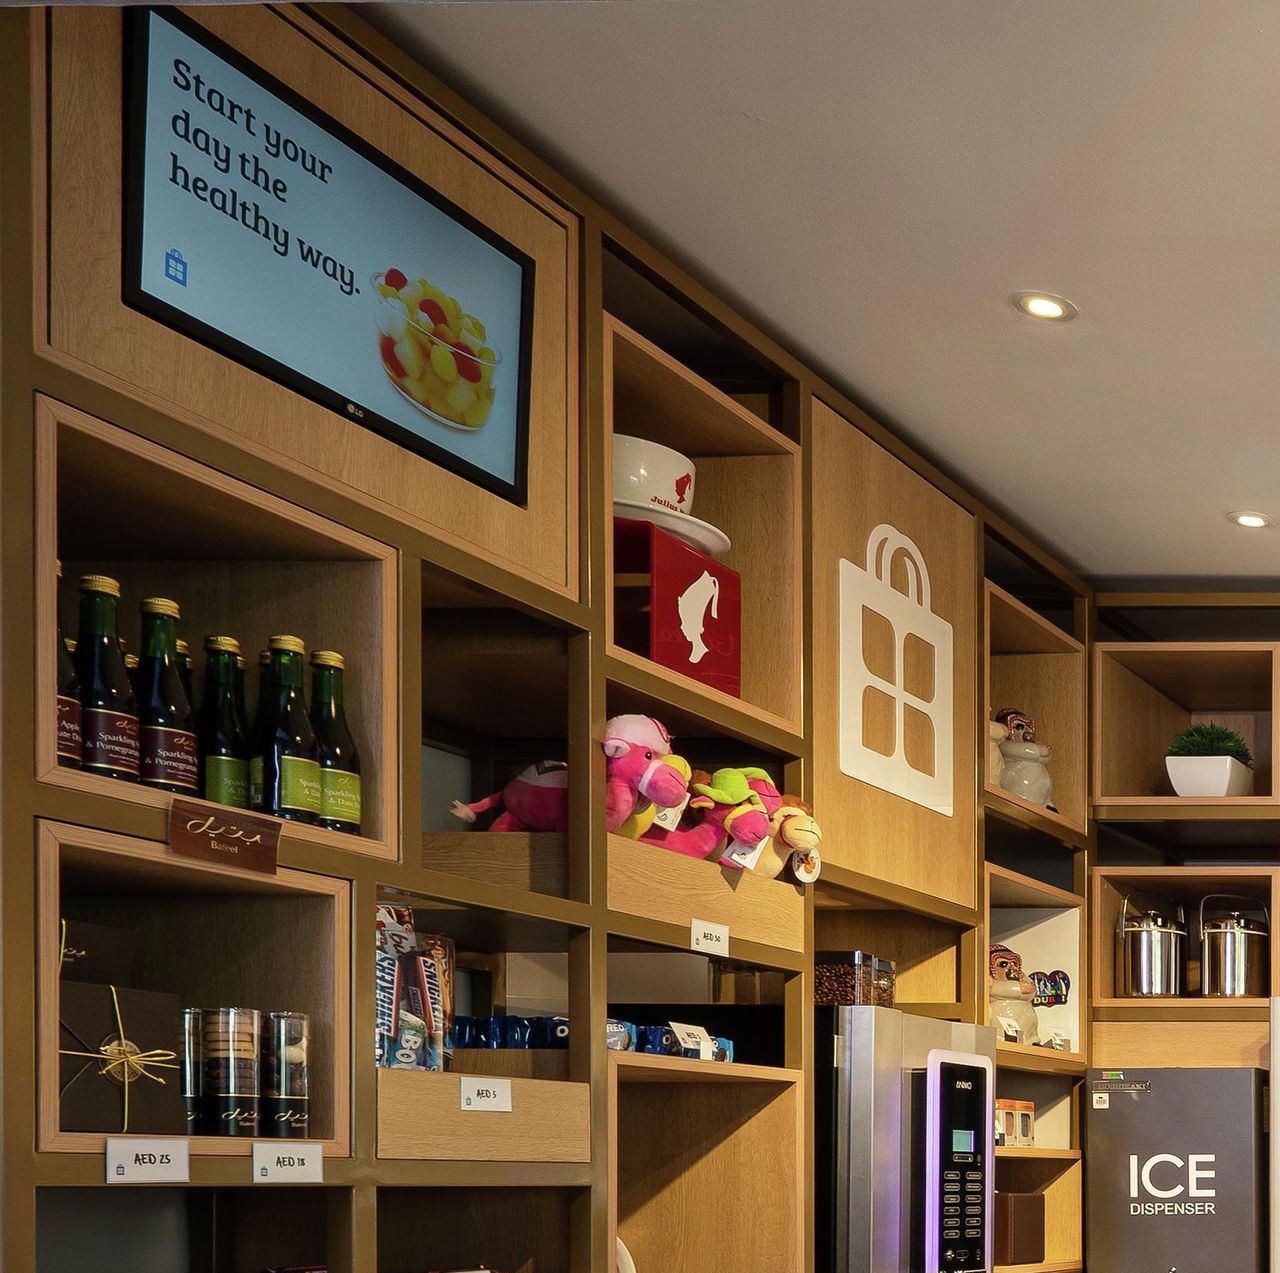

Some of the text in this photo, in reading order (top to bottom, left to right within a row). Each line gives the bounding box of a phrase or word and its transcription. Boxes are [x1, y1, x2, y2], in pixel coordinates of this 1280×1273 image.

[172, 58, 333, 184] Start your
[171, 110, 288, 203] day the
[169, 153, 361, 297] healthy way.
[354, 408, 364, 418] LG
[211, 840, 239, 854] Bateel
[476, 1088, 491, 1100] AED
[134, 1153, 171, 1166] AED 25
[275, 1156, 294, 1168] AED
[1129, 1153, 1217, 1199] ICE
[1130, 1201, 1217, 1216] DISPENSER
